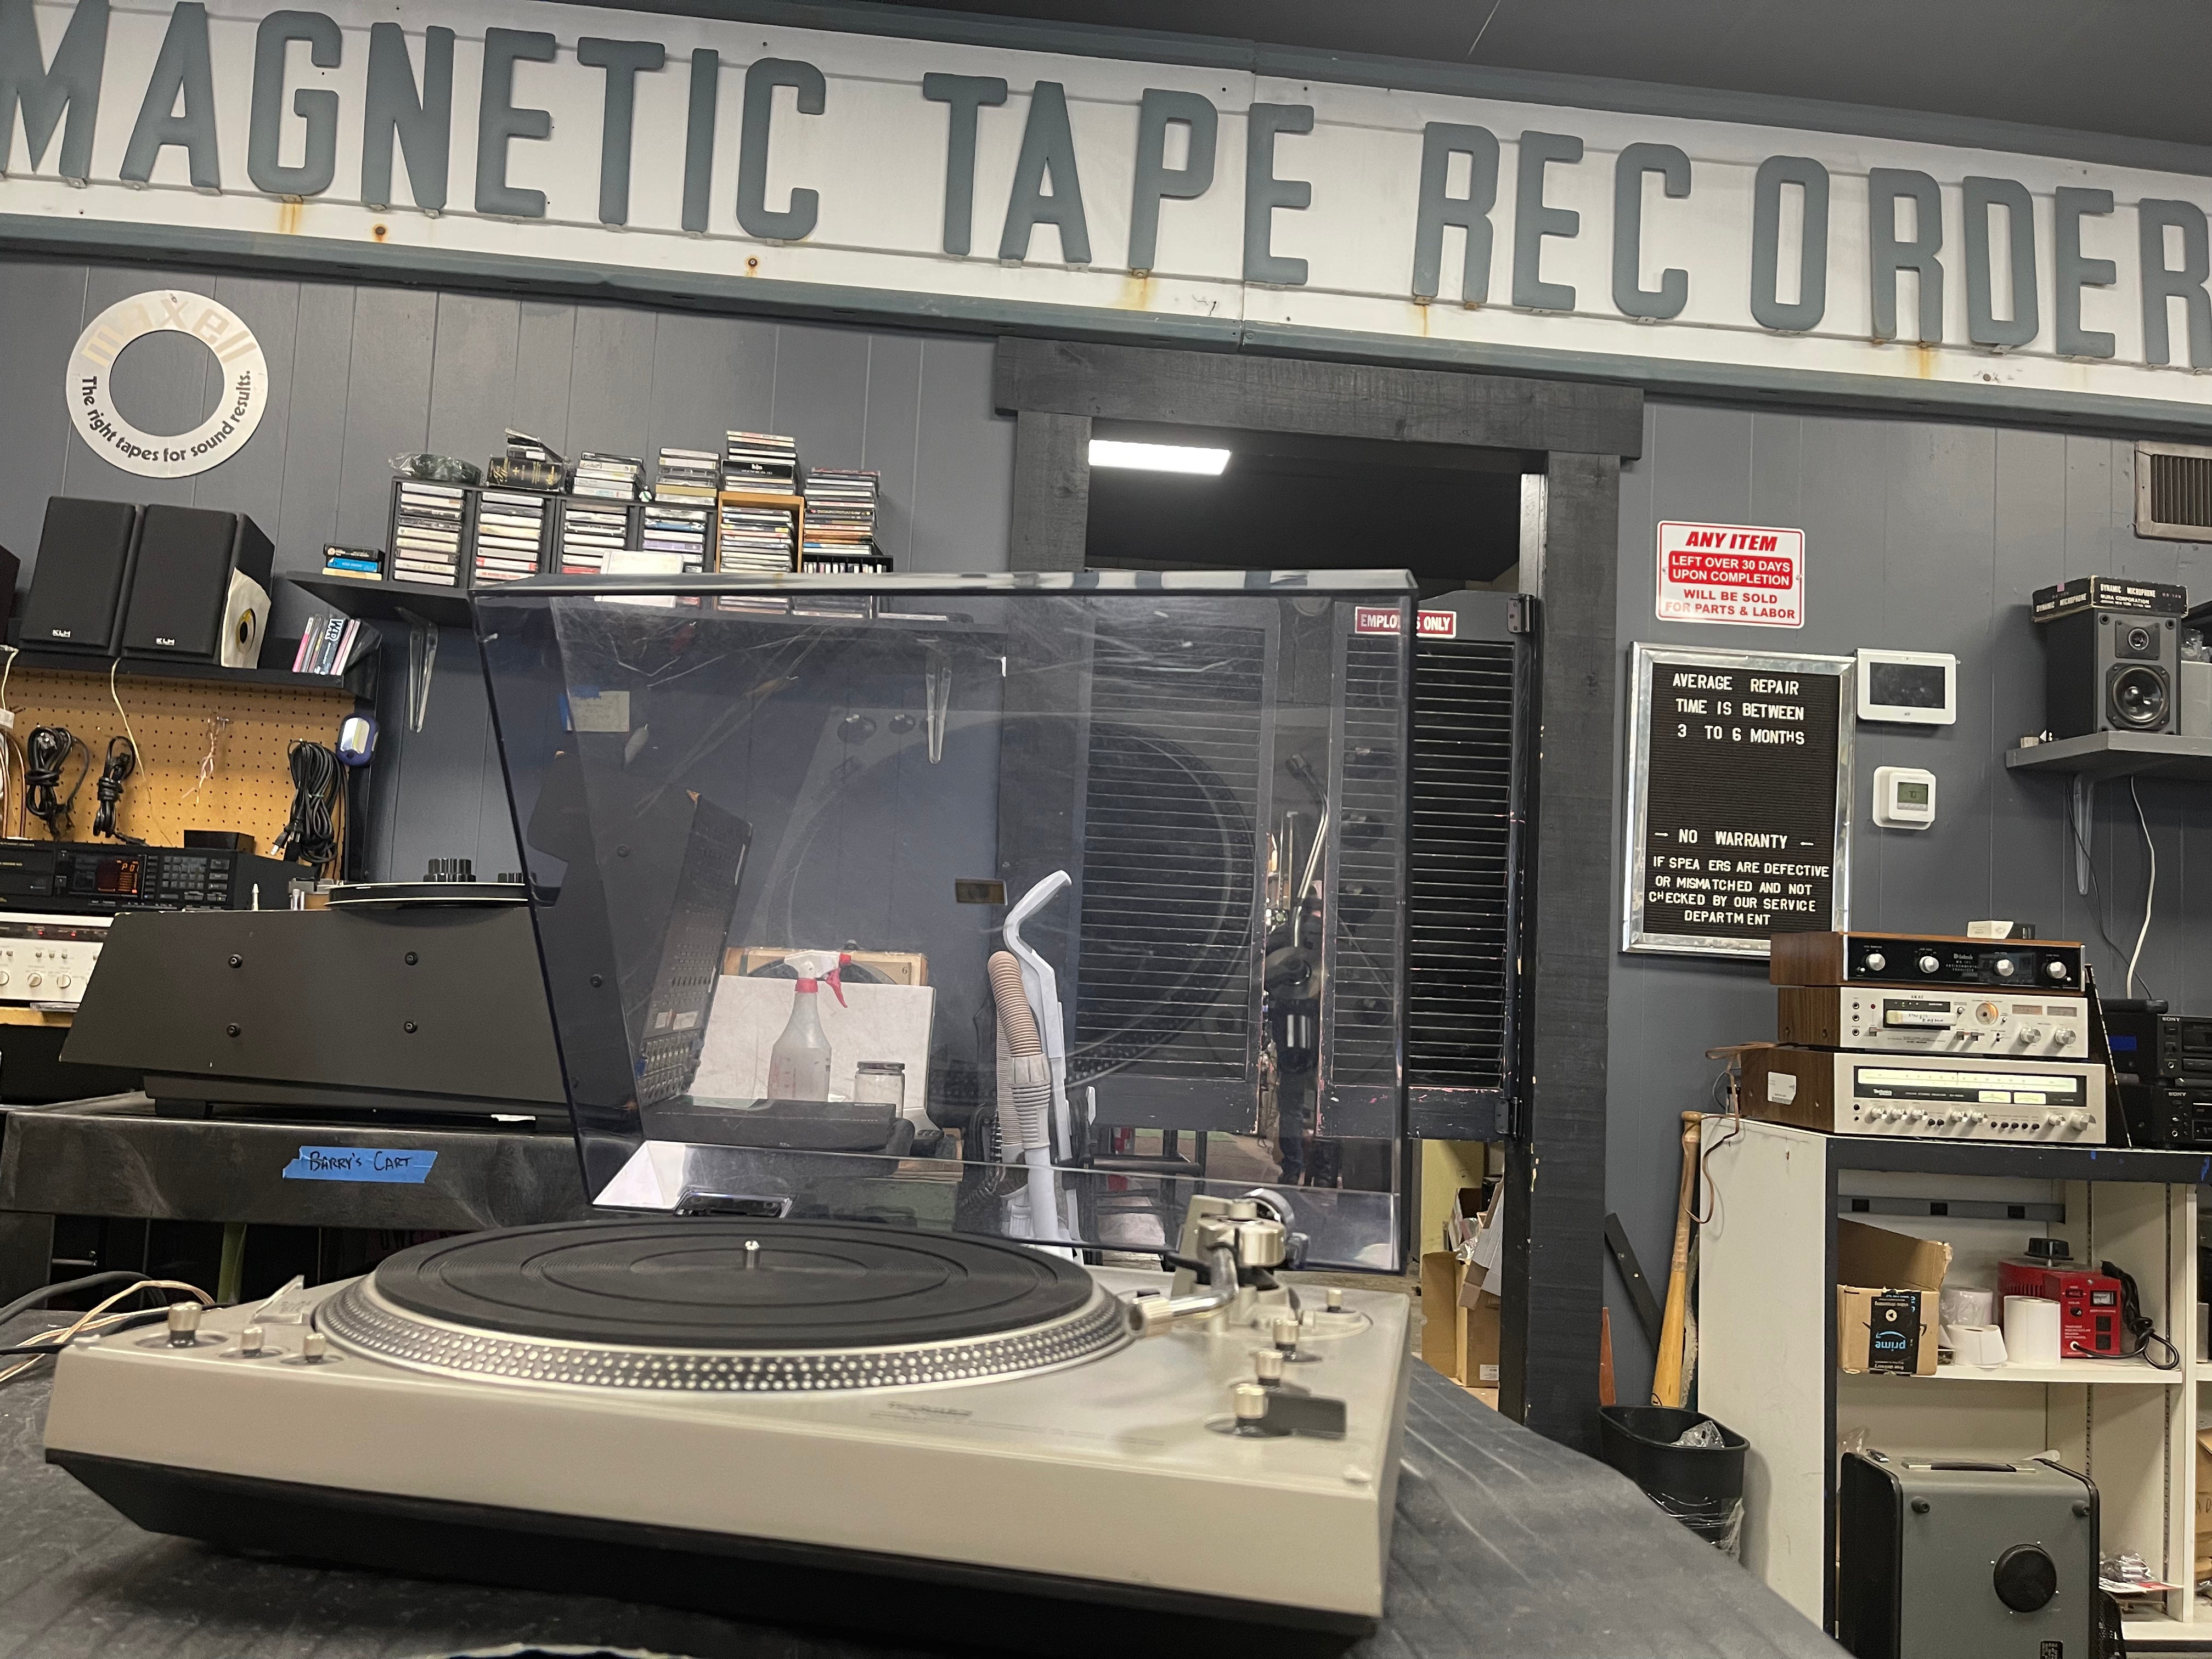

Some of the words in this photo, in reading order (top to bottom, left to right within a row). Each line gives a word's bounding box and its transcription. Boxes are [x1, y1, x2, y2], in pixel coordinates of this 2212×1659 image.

[0, 0, 826, 240] MAGNETIC
[923, 72, 1314, 285] TAPE
[81, 298, 257, 367] maxell
[82, 376, 97, 405] The
[230, 371, 250, 422] results.
[88, 409, 117, 441] right
[191, 421, 235, 456] sound
[116, 437, 159, 461] tapes
[163, 448, 186, 461] for
[1685, 531, 1727, 548] ANY
[1730, 534, 1778, 552] ITEM
[1672, 555, 1702, 566] LEFT
[1705, 557, 1739, 569] OVER
[1742, 560, 1755, 570] 30
[1759, 561, 1790, 572] DAYS
[1673, 569, 1707, 580] UPON
[1711, 571, 1790, 585] COMPLETION
[1684, 589, 1716, 600] WILL
[1721, 591, 1737, 601] BE
[1742, 592, 1778, 604] SOLD
[2100, 584, 2121, 593] DYNAMIC
[2127, 586, 2155, 598] MICROPHONE
[2115, 595, 2150, 605] CORPORATION
[1666, 601, 1691, 612] FOR
[1695, 603, 1735, 615] PARTS
[1740, 606, 1748, 616] &
[1753, 607, 1795, 619] LABOR
[2036, 601, 2055, 613] DYNAMIC
[2059, 593, 2087, 606] MICROPHONE
[53, 629, 71, 637] KLH
[1424, 616, 1451, 631] ONLY
[156, 637, 174, 646] KLH
[1673, 673, 1733, 690] AVERAGE
[1751, 678, 1799, 695] REPAIR
[1675, 698, 1707, 714] TIME
[1717, 701, 1731, 715] IS
[1742, 702, 1804, 720] BETWEEN
[1678, 724, 1687, 737] 3
[1704, 725, 1723, 740] TO
[1733, 727, 1741, 741] 6
[1750, 728, 1805, 745] MONTHS
[1679, 828, 1697, 844] NO
[1715, 831, 1787, 849] WARRANTY
[1654, 856, 1665, 867] IF
[1736, 861, 1760, 873] ARE
[1764, 862, 1830, 877] DEFECTIVE
[1655, 876, 1671, 888] OR
[1677, 877, 1752, 892] MISMATCHED
[1759, 882, 1781, 894] AND
[1788, 883, 1812, 895] NOT
[1649, 891, 1705, 905] CHECKED
[1713, 895, 1727, 907] BY
[1734, 896, 1757, 909] OUR
[1763, 899, 1816, 912] SERVICE
[1684, 910, 1771, 926] DEPARTMENT
[1875, 1340, 1906, 1351] prime
